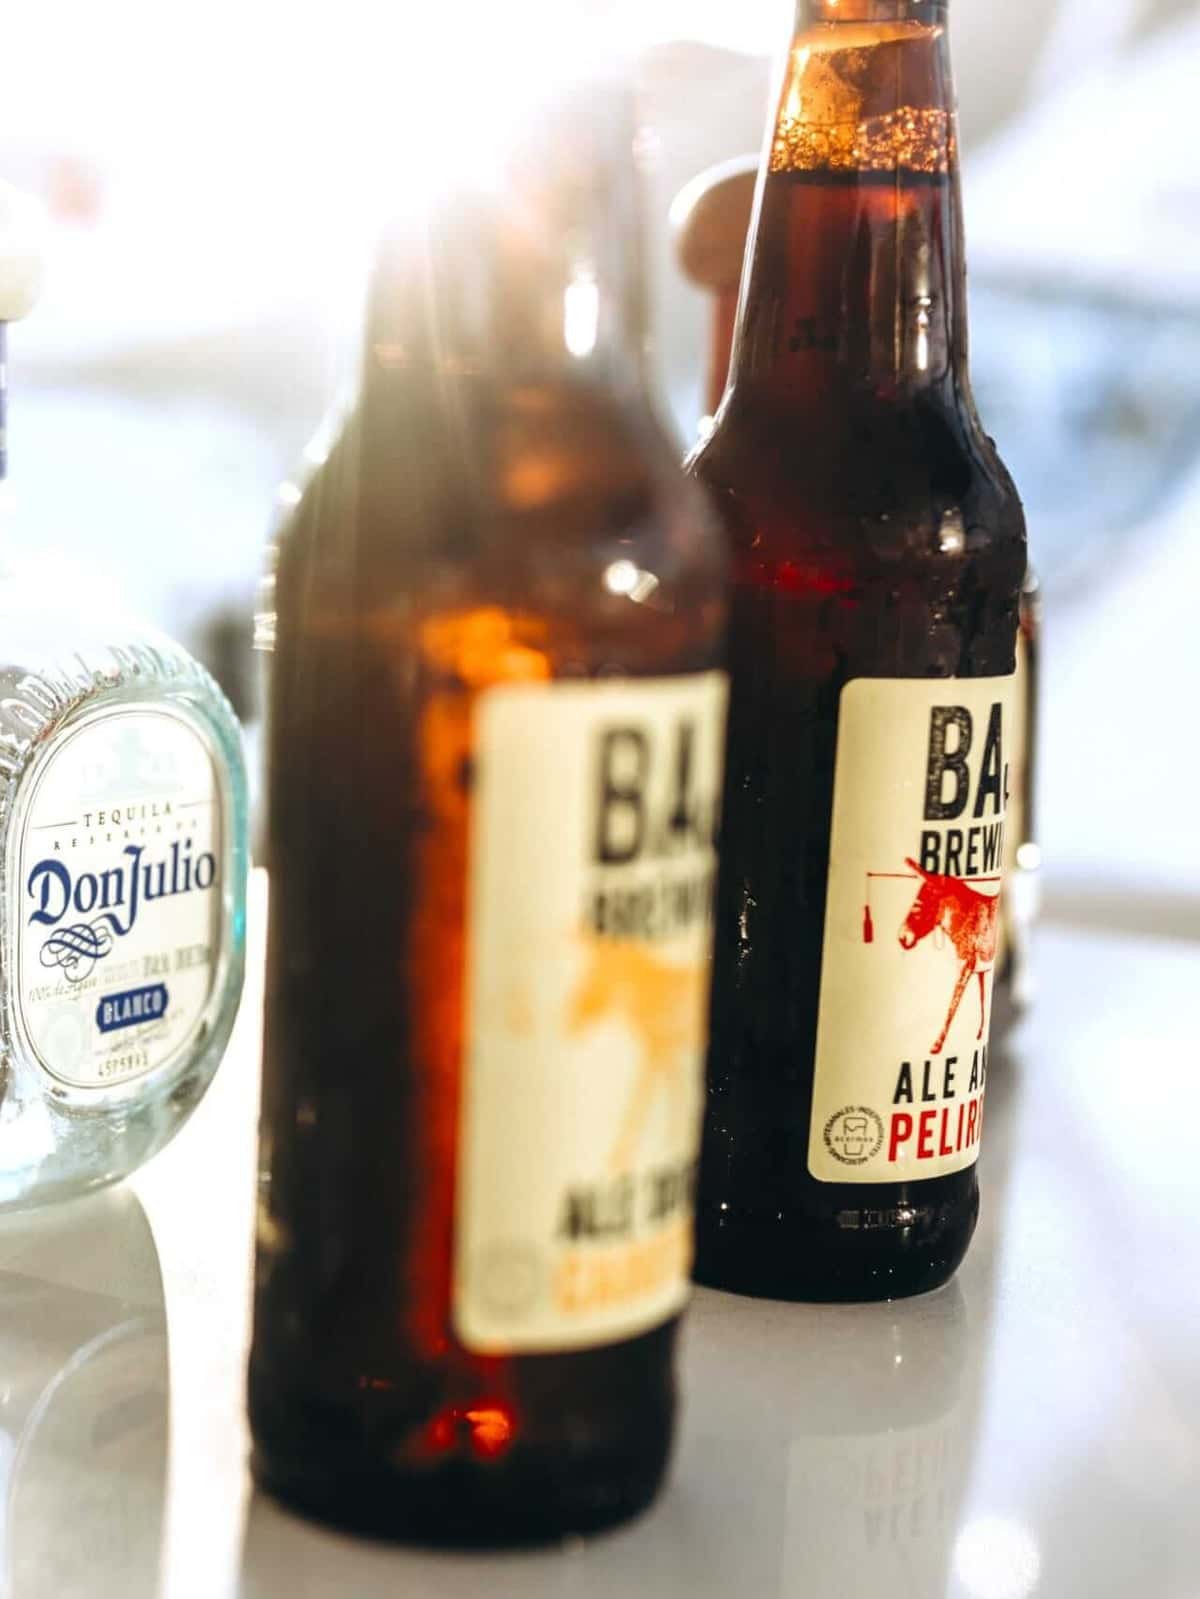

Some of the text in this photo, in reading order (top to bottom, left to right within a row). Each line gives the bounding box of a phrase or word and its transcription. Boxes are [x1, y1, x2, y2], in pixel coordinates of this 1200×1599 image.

[83, 801, 173, 828] TEQUILA
[102, 990, 163, 1026] BLANCO
[893, 1057, 958, 1104] ALE
